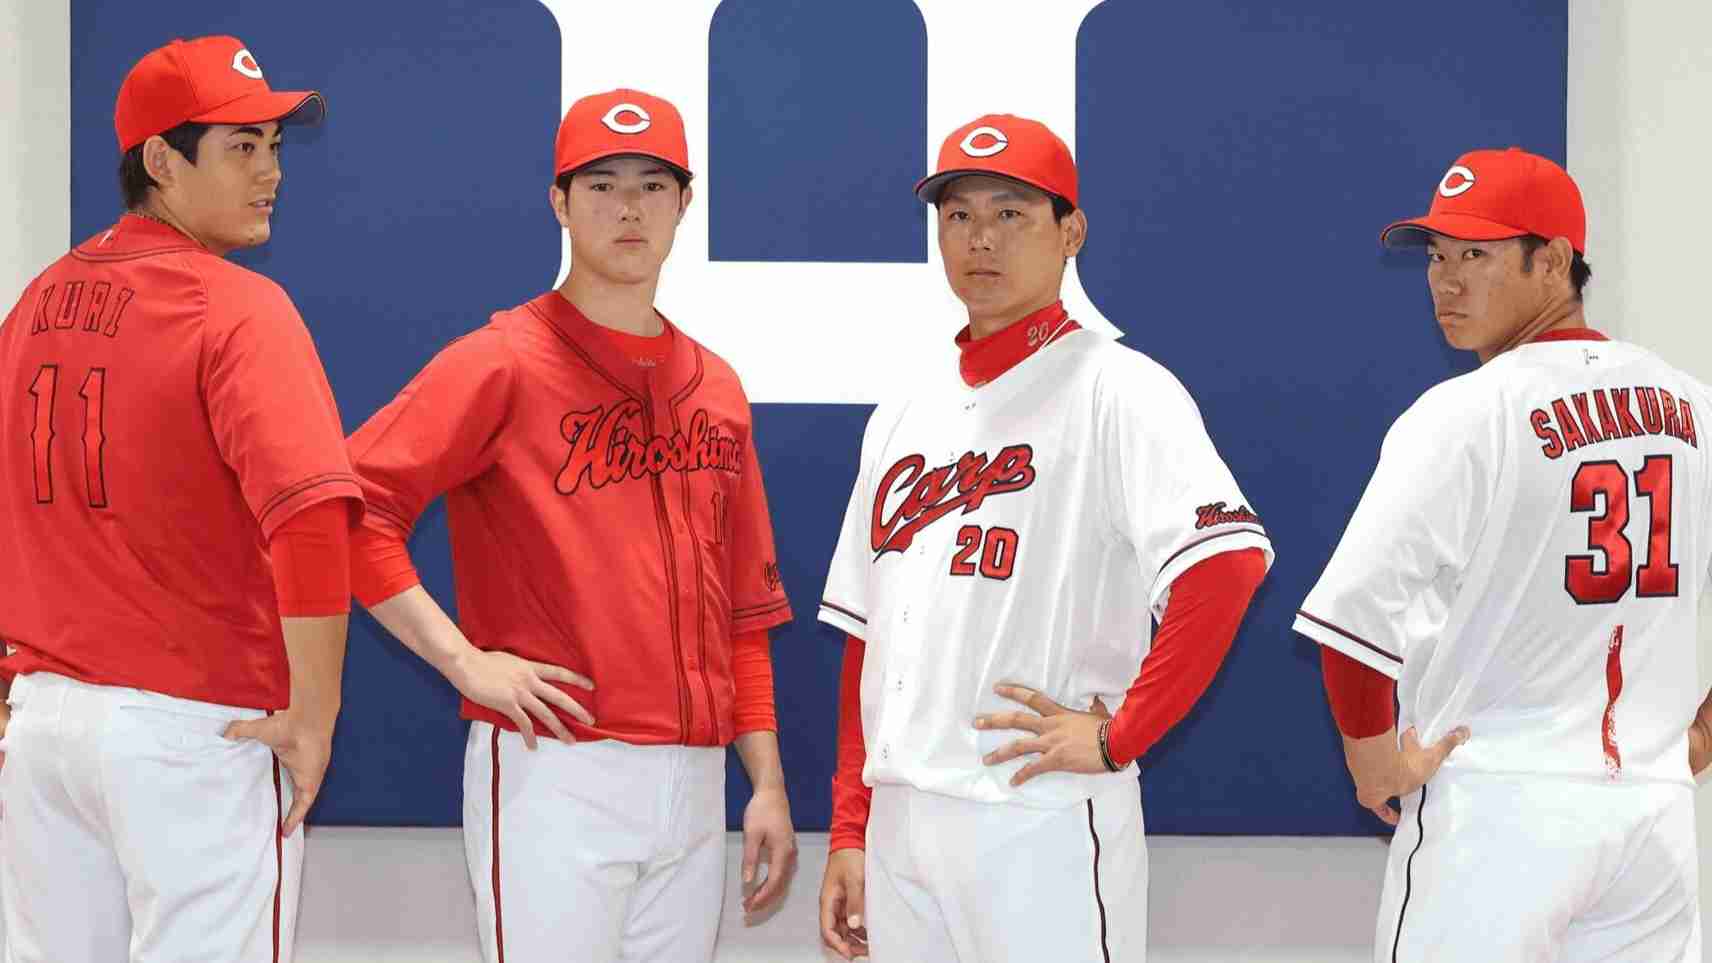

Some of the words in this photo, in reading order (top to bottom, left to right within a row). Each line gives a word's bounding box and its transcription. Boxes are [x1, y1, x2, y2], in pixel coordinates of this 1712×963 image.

[600, 103, 651, 135] C
[960, 126, 1008, 158] C
[1439, 165, 1476, 198] C
[31, 280, 135, 338] KURI
[1027, 320, 1049, 347] 20
[28, 363, 108, 509] 11
[1529, 386, 1698, 460] SAKAKURA
[870, 443, 1036, 563] Carp
[1564, 454, 1680, 605] 31
[949, 524, 1020, 581] 20
